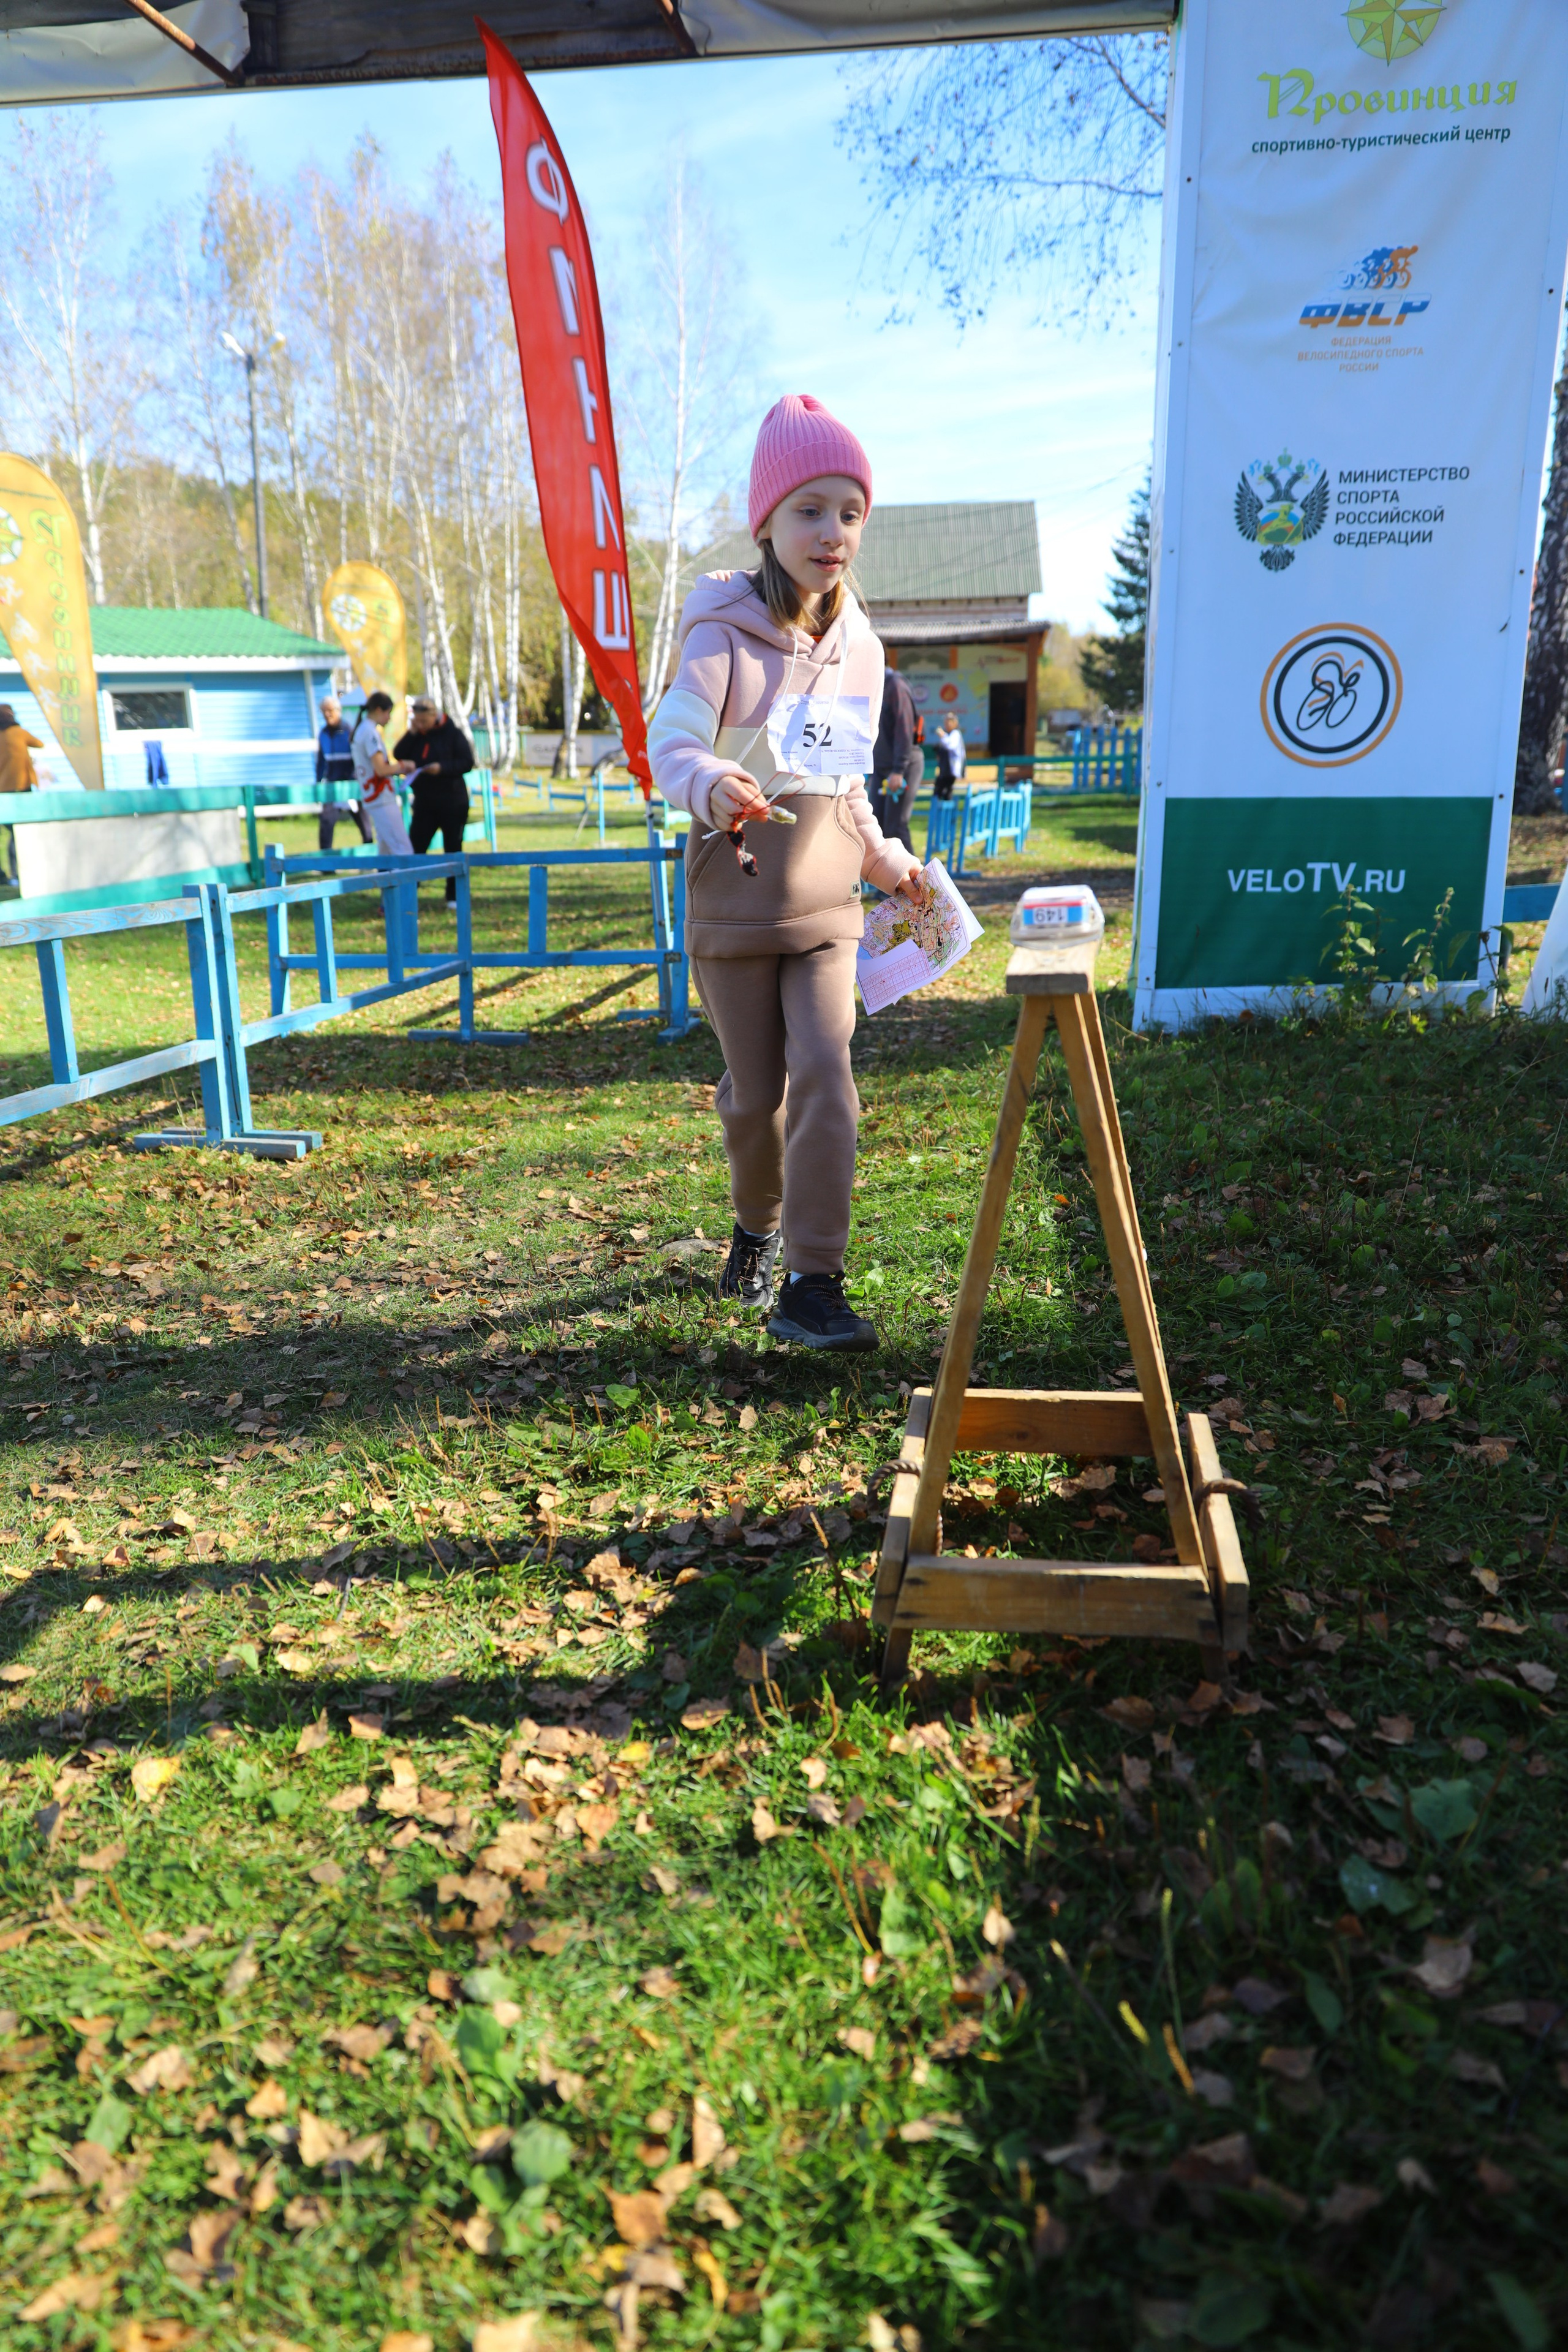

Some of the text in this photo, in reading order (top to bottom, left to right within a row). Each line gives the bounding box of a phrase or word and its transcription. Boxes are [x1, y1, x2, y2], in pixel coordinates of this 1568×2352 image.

[1257, 68, 1517, 125] Провинция
[1251, 126, 1511, 155] спортивно-туристический центр
[1298, 293, 1432, 328] ФВСР
[1330, 336, 1392, 347] ФЕДЕРАЦИЯ
[1297, 347, 1424, 361] ВЕЛОСИПЕДНОГО СПОРТА
[1339, 363, 1379, 372] РОССИИ
[1339, 466, 1470, 484] МИНИСТЕРСТВО
[1337, 490, 1400, 505] СПОРТА
[1335, 505, 1445, 525] РОССИЙСКОЙ
[1333, 530, 1433, 548] ФЕДЕРАЦИИ
[802, 723, 832, 747] 52
[1035, 907, 1065, 922] 149
